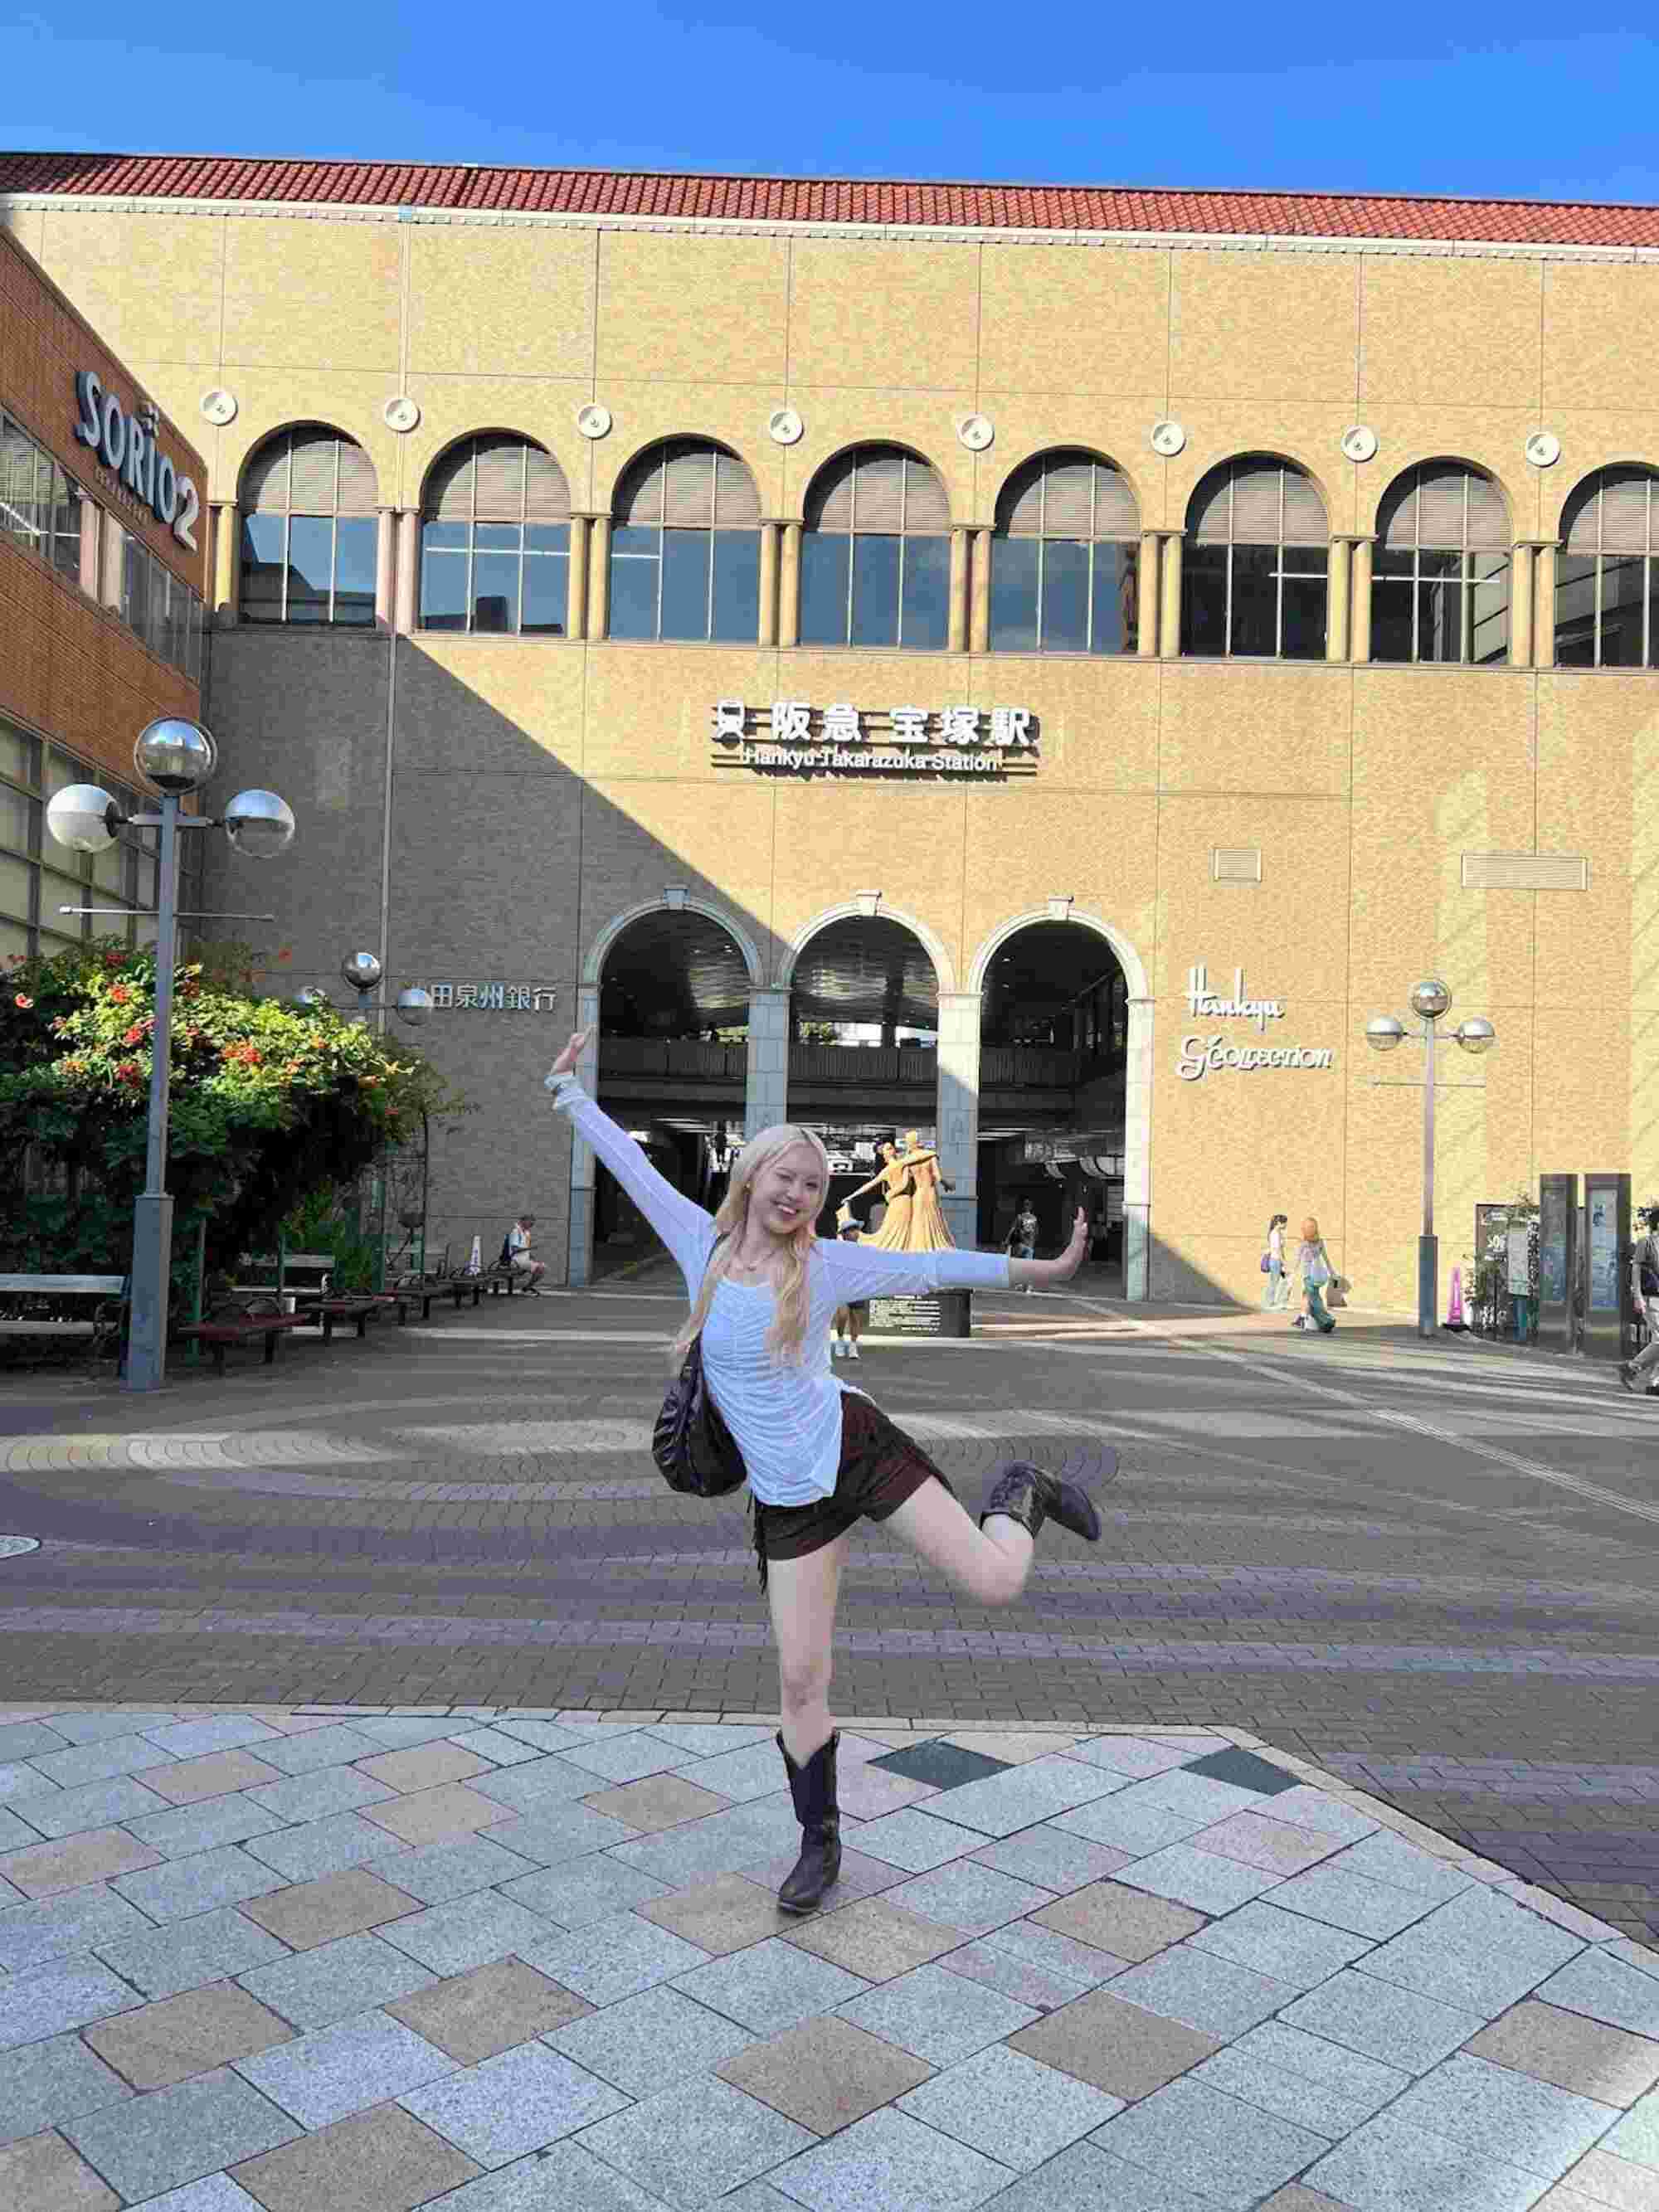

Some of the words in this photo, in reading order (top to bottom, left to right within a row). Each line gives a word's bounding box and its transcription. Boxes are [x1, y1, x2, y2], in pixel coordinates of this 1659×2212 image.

[743, 747, 815, 769] Hankyu
[820, 748, 927, 769] Takarazuka
[932, 751, 997, 771] Station
[403, 982, 557, 1011] 田泉州銀行
